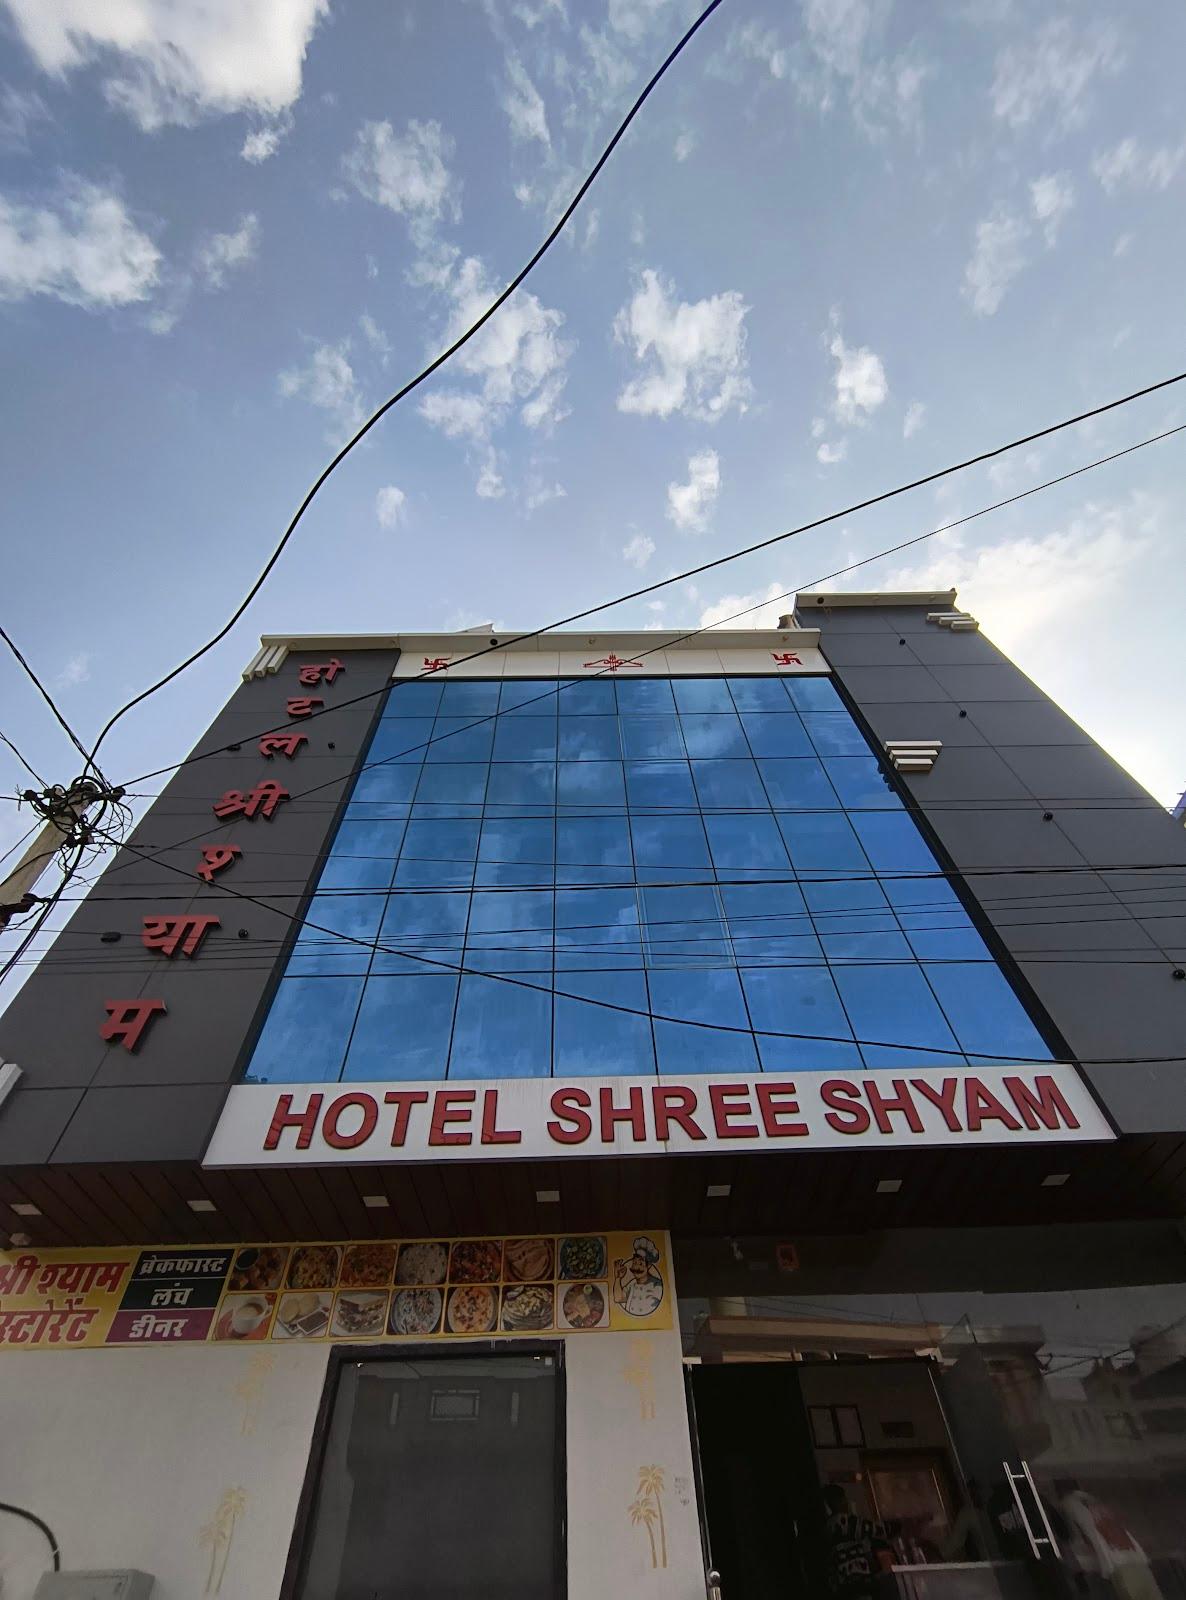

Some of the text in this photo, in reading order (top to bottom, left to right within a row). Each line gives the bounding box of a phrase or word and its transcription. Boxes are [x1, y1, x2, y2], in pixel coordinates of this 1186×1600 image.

[263, 1075, 1081, 1151] HOTEL SHREE SHYAM
[36, 1262, 131, 1294] श्याम
[151, 1282, 194, 1306] लंच
[128, 1314, 189, 1338] डीनर
